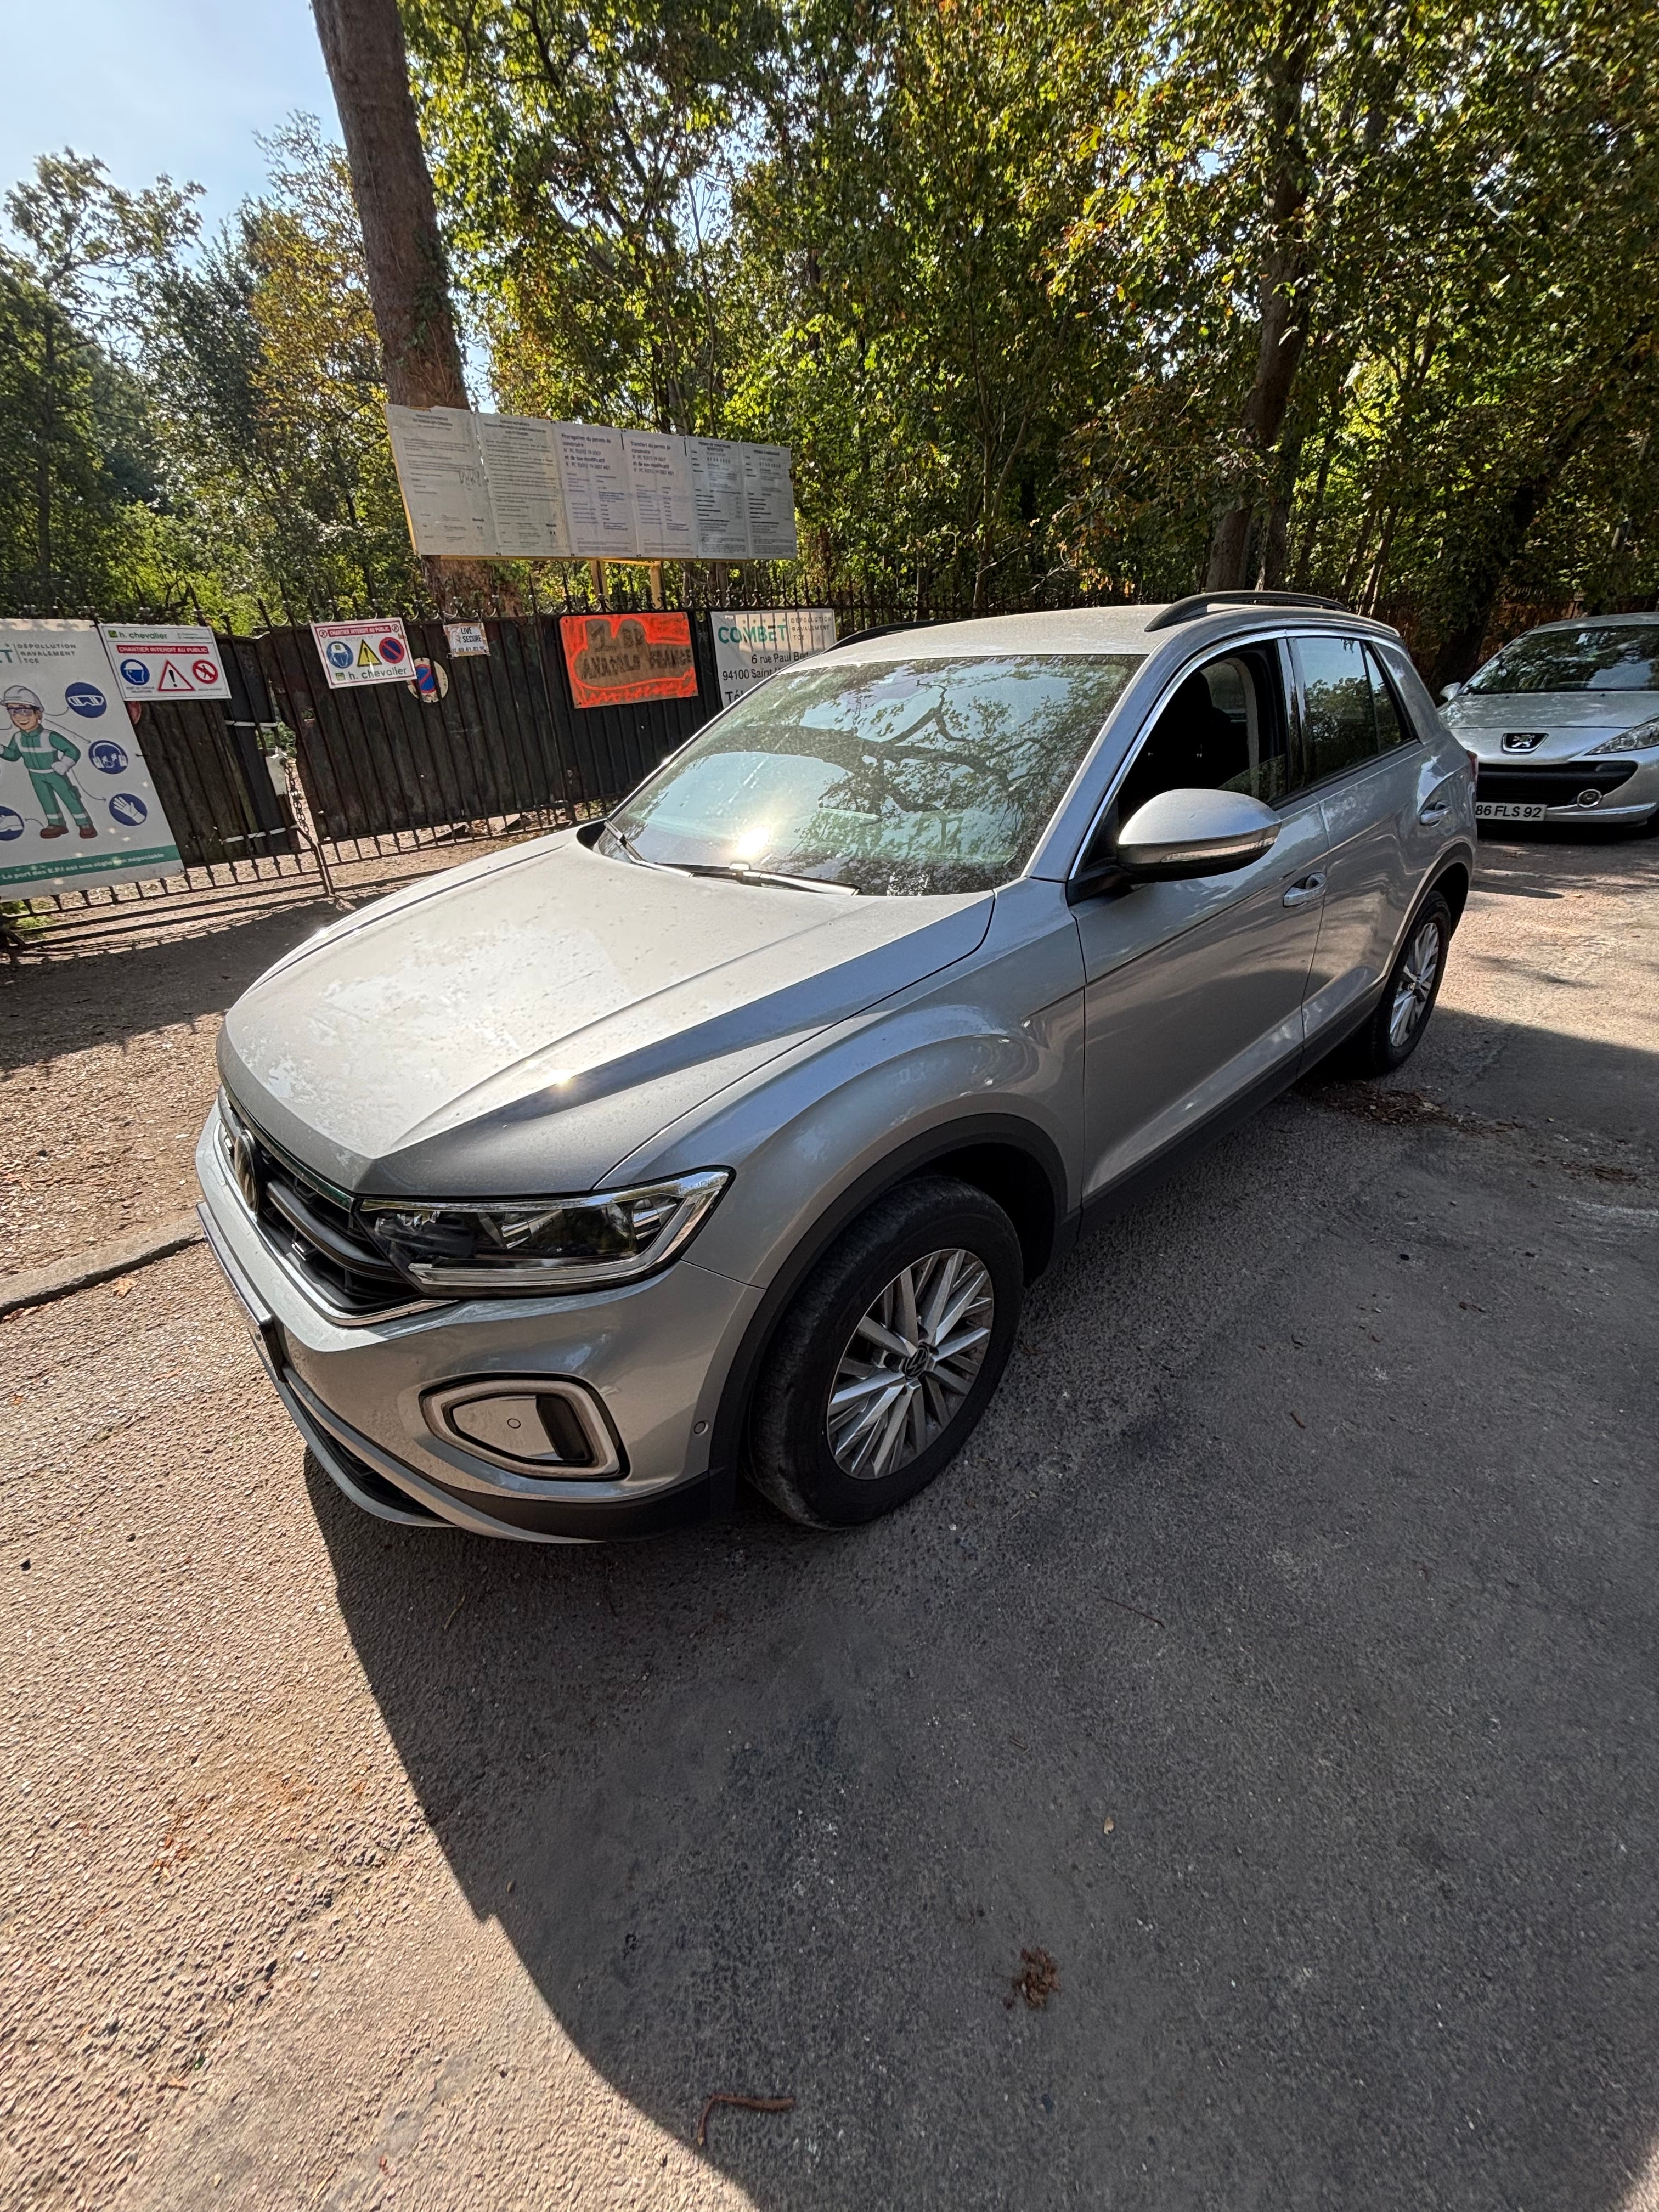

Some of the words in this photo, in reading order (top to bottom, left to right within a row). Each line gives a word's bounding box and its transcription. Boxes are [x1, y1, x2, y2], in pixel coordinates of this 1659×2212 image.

[718, 625, 786, 644] COMBET
[752, 654, 758, 664] 6
[773, 653, 791, 663] Paul
[348, 672, 358, 680] h.
[362, 667, 407, 678] chevalier
[723, 669, 749, 681] 94100
[751, 668, 772, 678] Saint
[1494, 805, 1521, 817] FLS
[1523, 806, 1542, 818] 92
